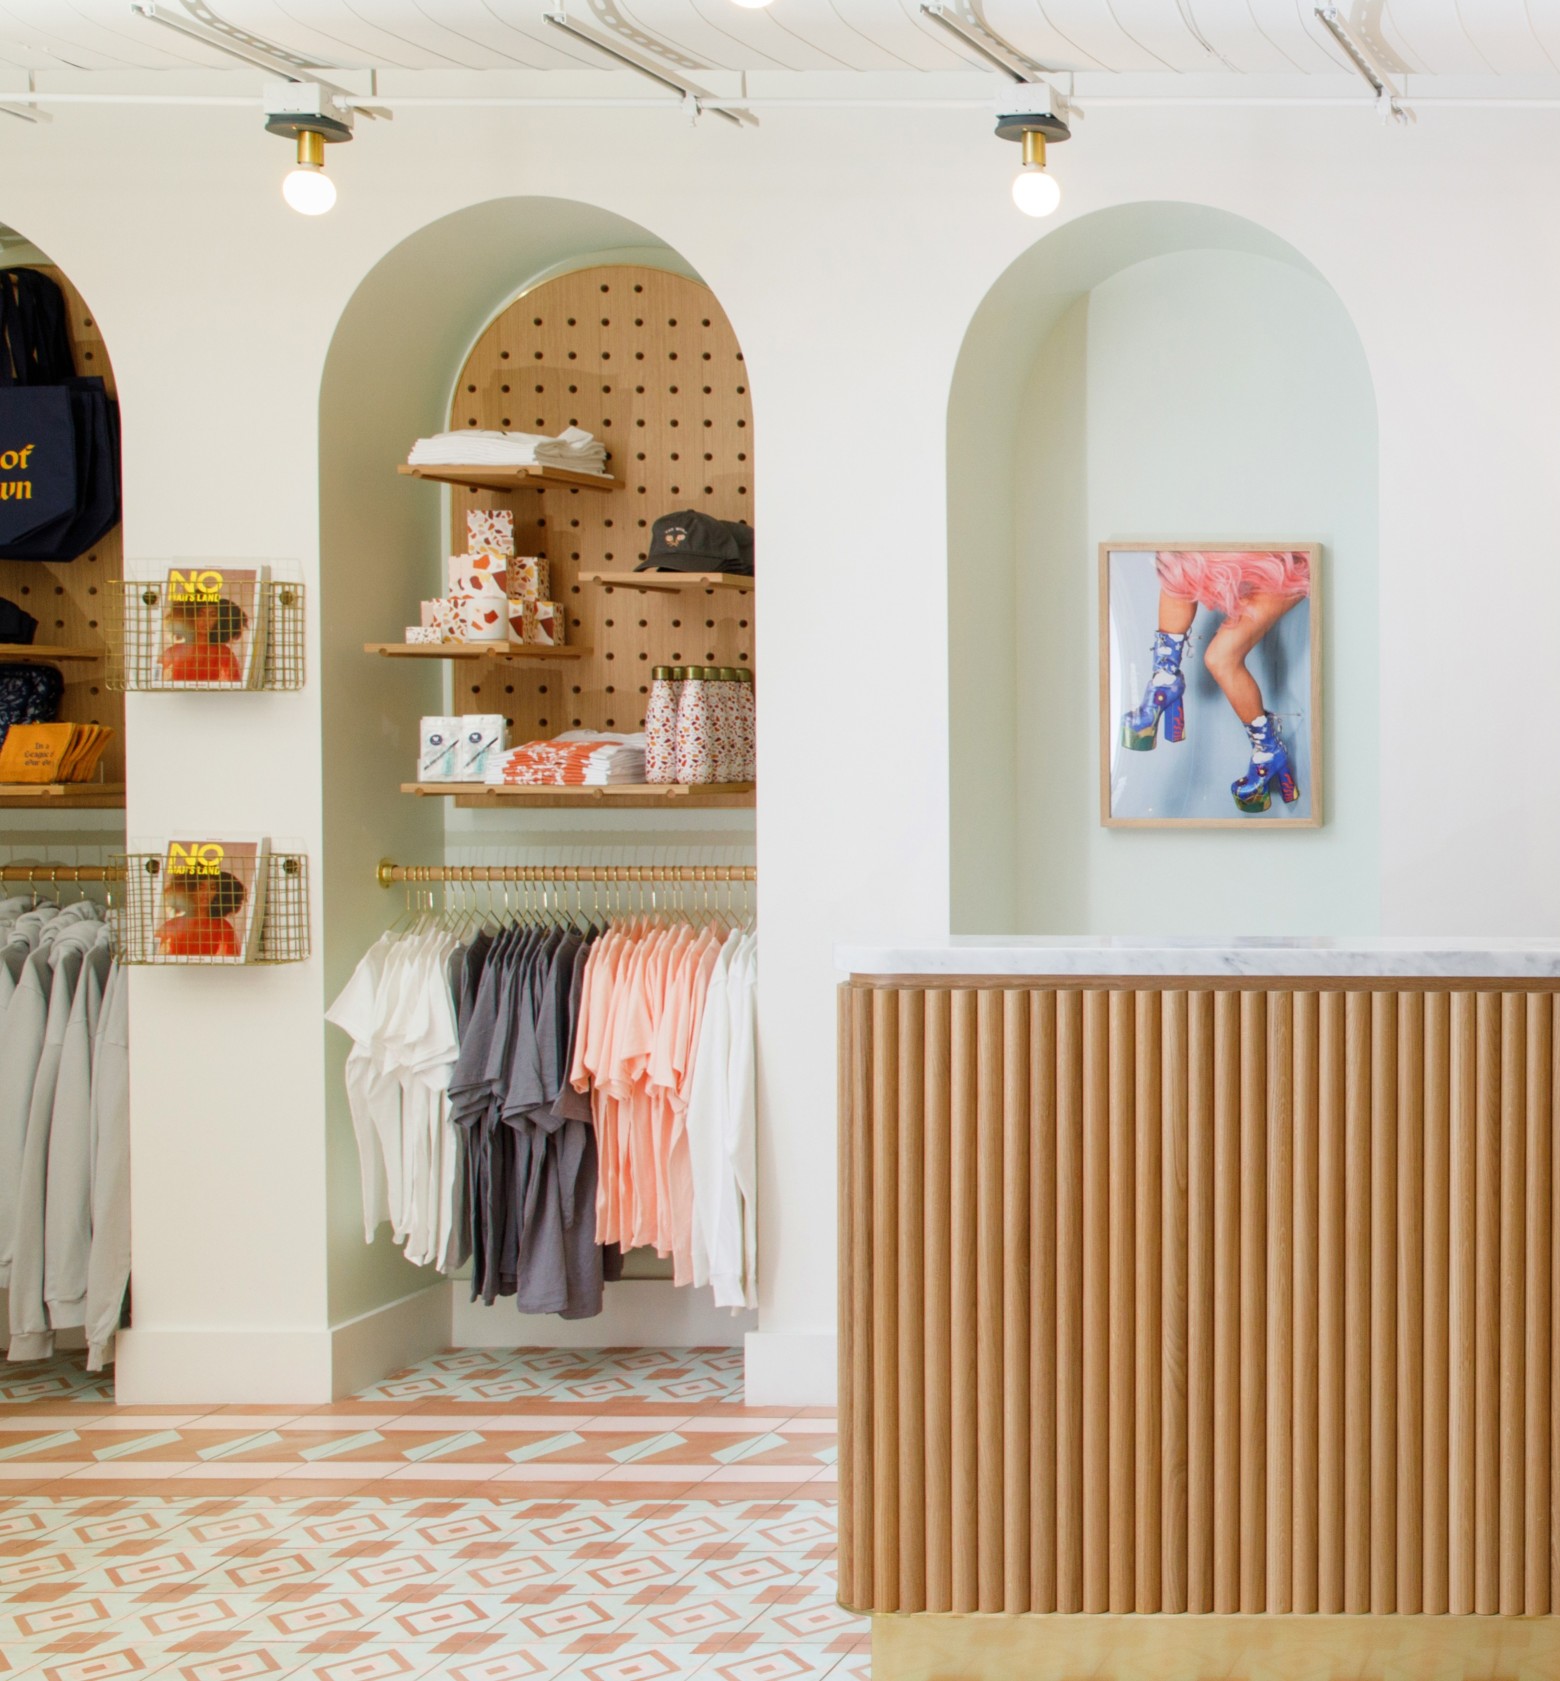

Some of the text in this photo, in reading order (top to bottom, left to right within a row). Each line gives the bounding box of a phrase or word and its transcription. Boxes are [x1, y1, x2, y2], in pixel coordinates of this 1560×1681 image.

[0, 444, 36, 470] of
[169, 570, 223, 594] NO
[196, 593, 221, 603] LAND
[169, 842, 225, 867] NO
[197, 866, 221, 876] LAND
